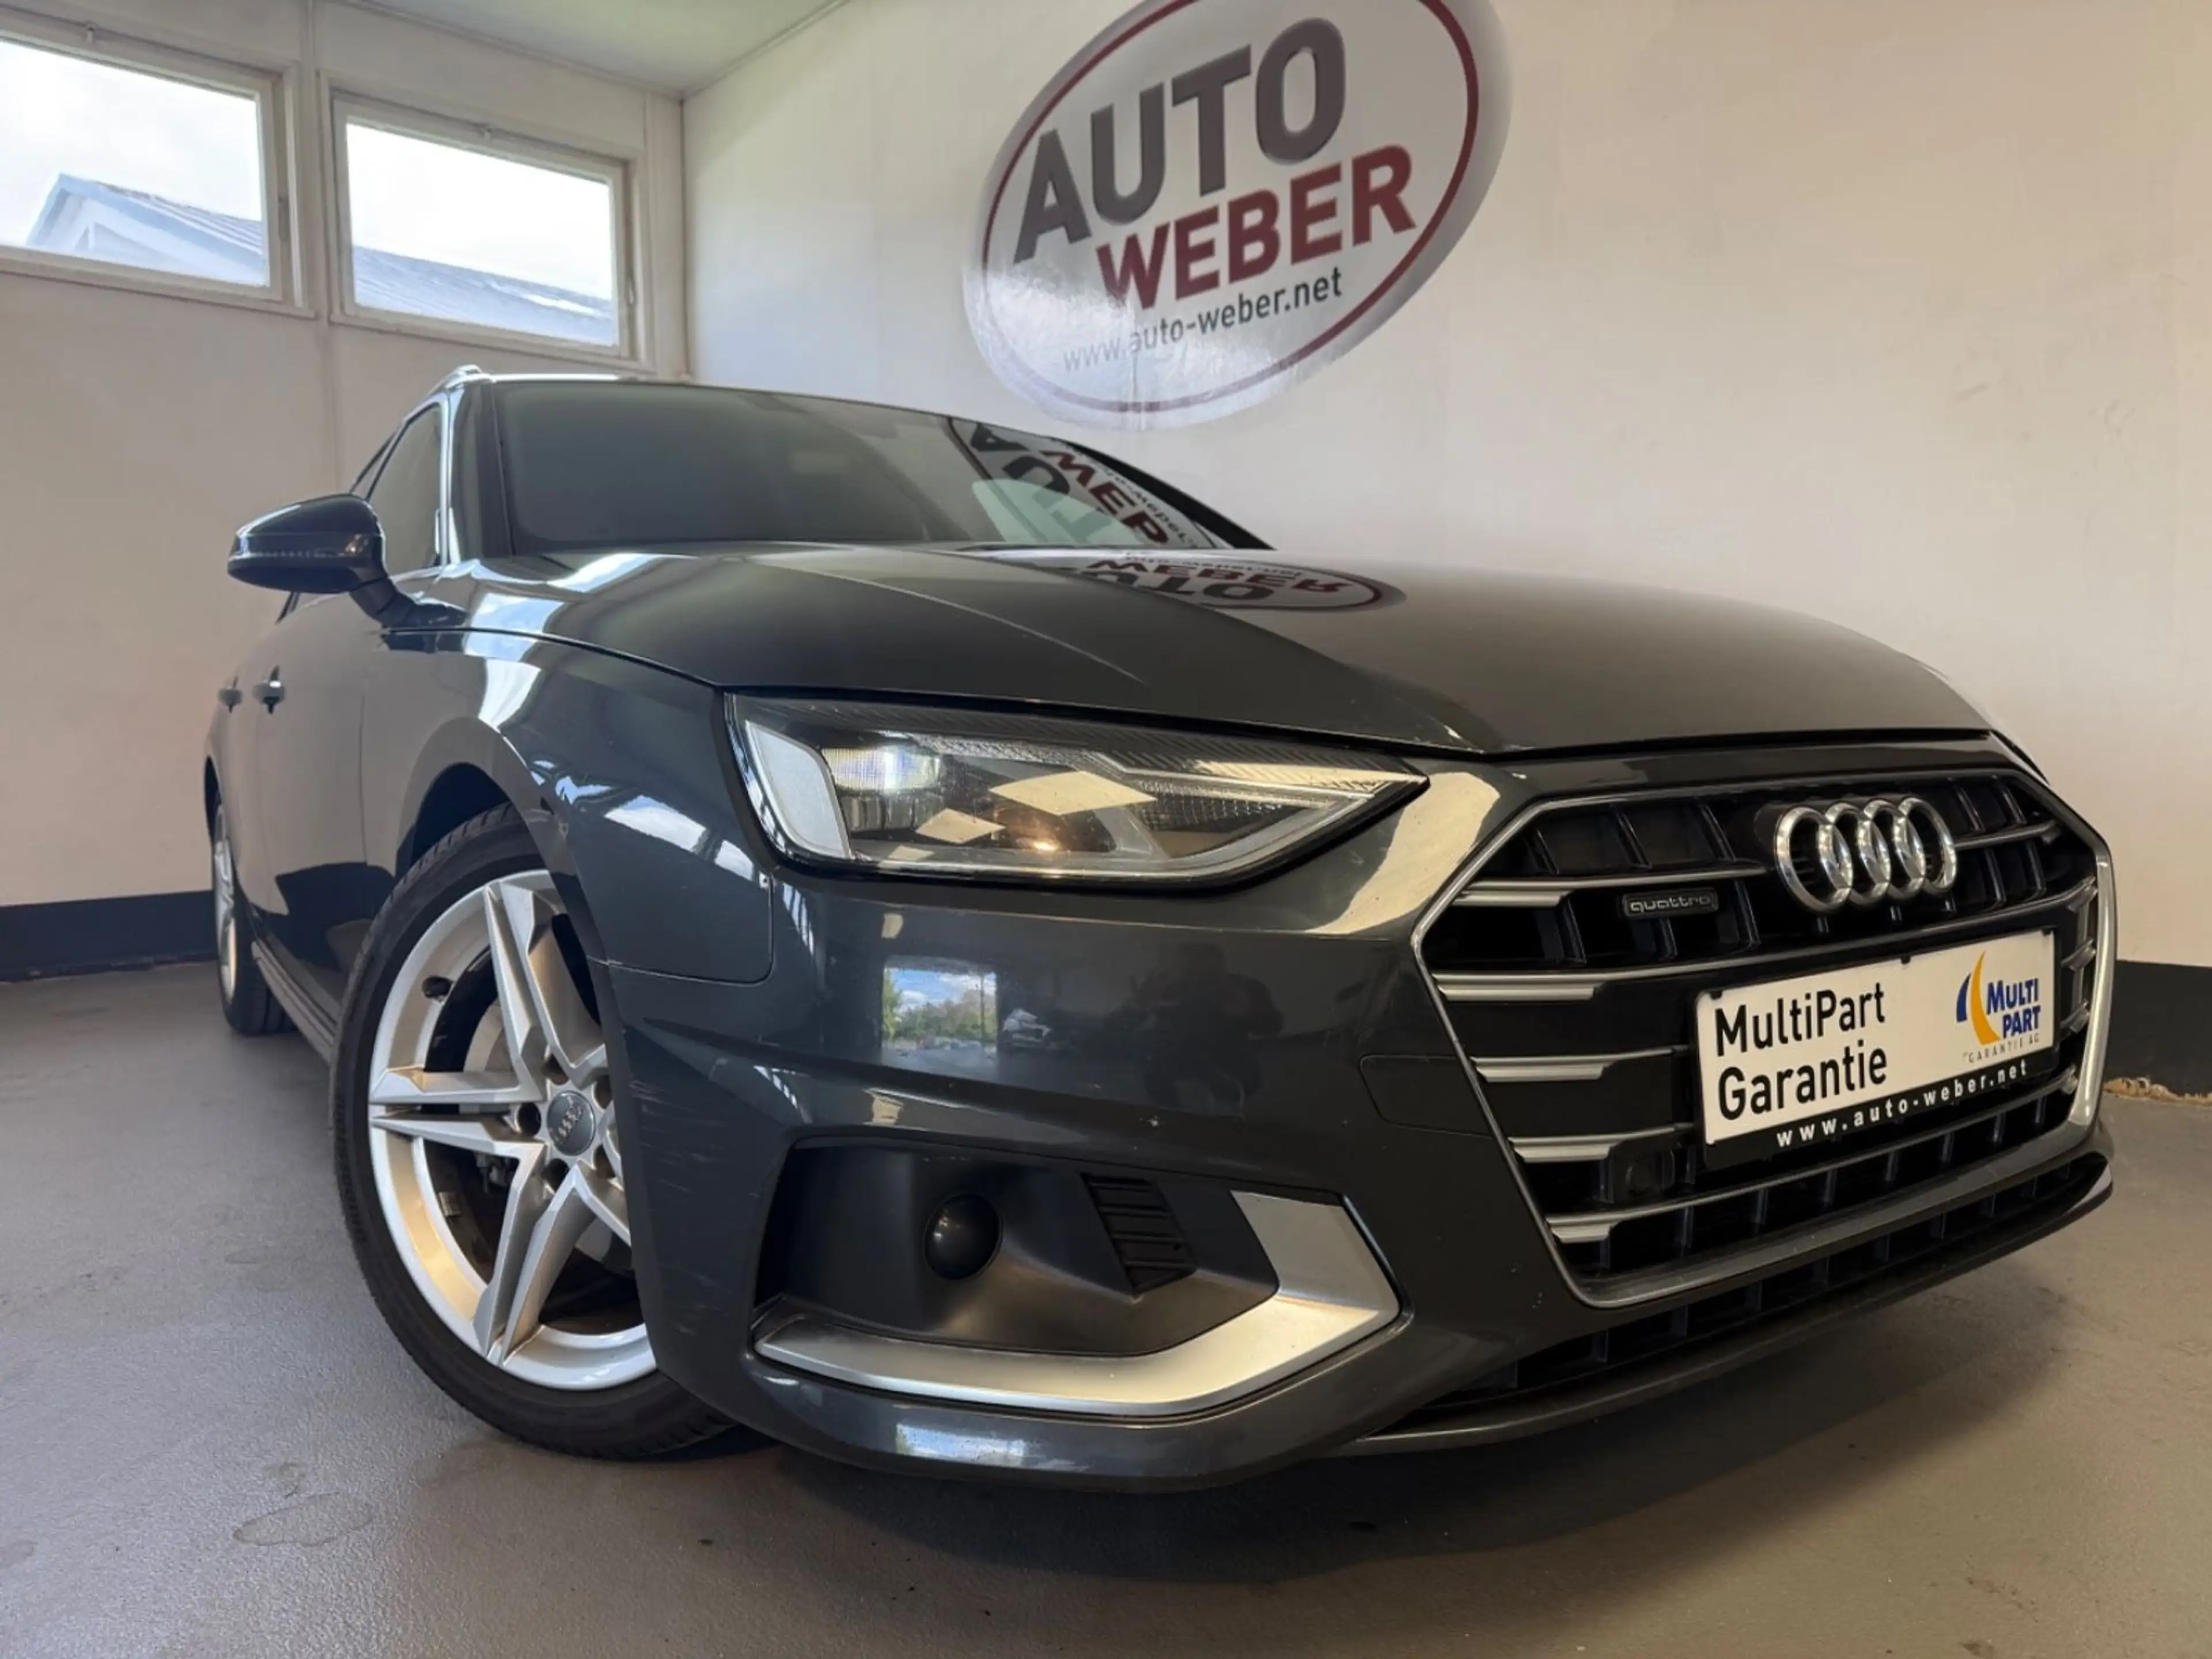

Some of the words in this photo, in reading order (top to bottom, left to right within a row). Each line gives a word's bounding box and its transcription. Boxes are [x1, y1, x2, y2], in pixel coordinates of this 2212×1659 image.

[1013, 17, 1346, 264] AUTO
[1096, 144, 1416, 311] WEBER
[1063, 266, 1342, 372] www.auto-weber.net
[1630, 896, 1711, 912] quattro
[1714, 982, 1885, 1057] MultiPart
[1987, 978, 2039, 1016] MULTI
[2002, 1005, 2041, 1039] PART
[1718, 1039, 1887, 1120] Garantie
[1777, 1059, 2027, 1147] www.auto-weber.net
